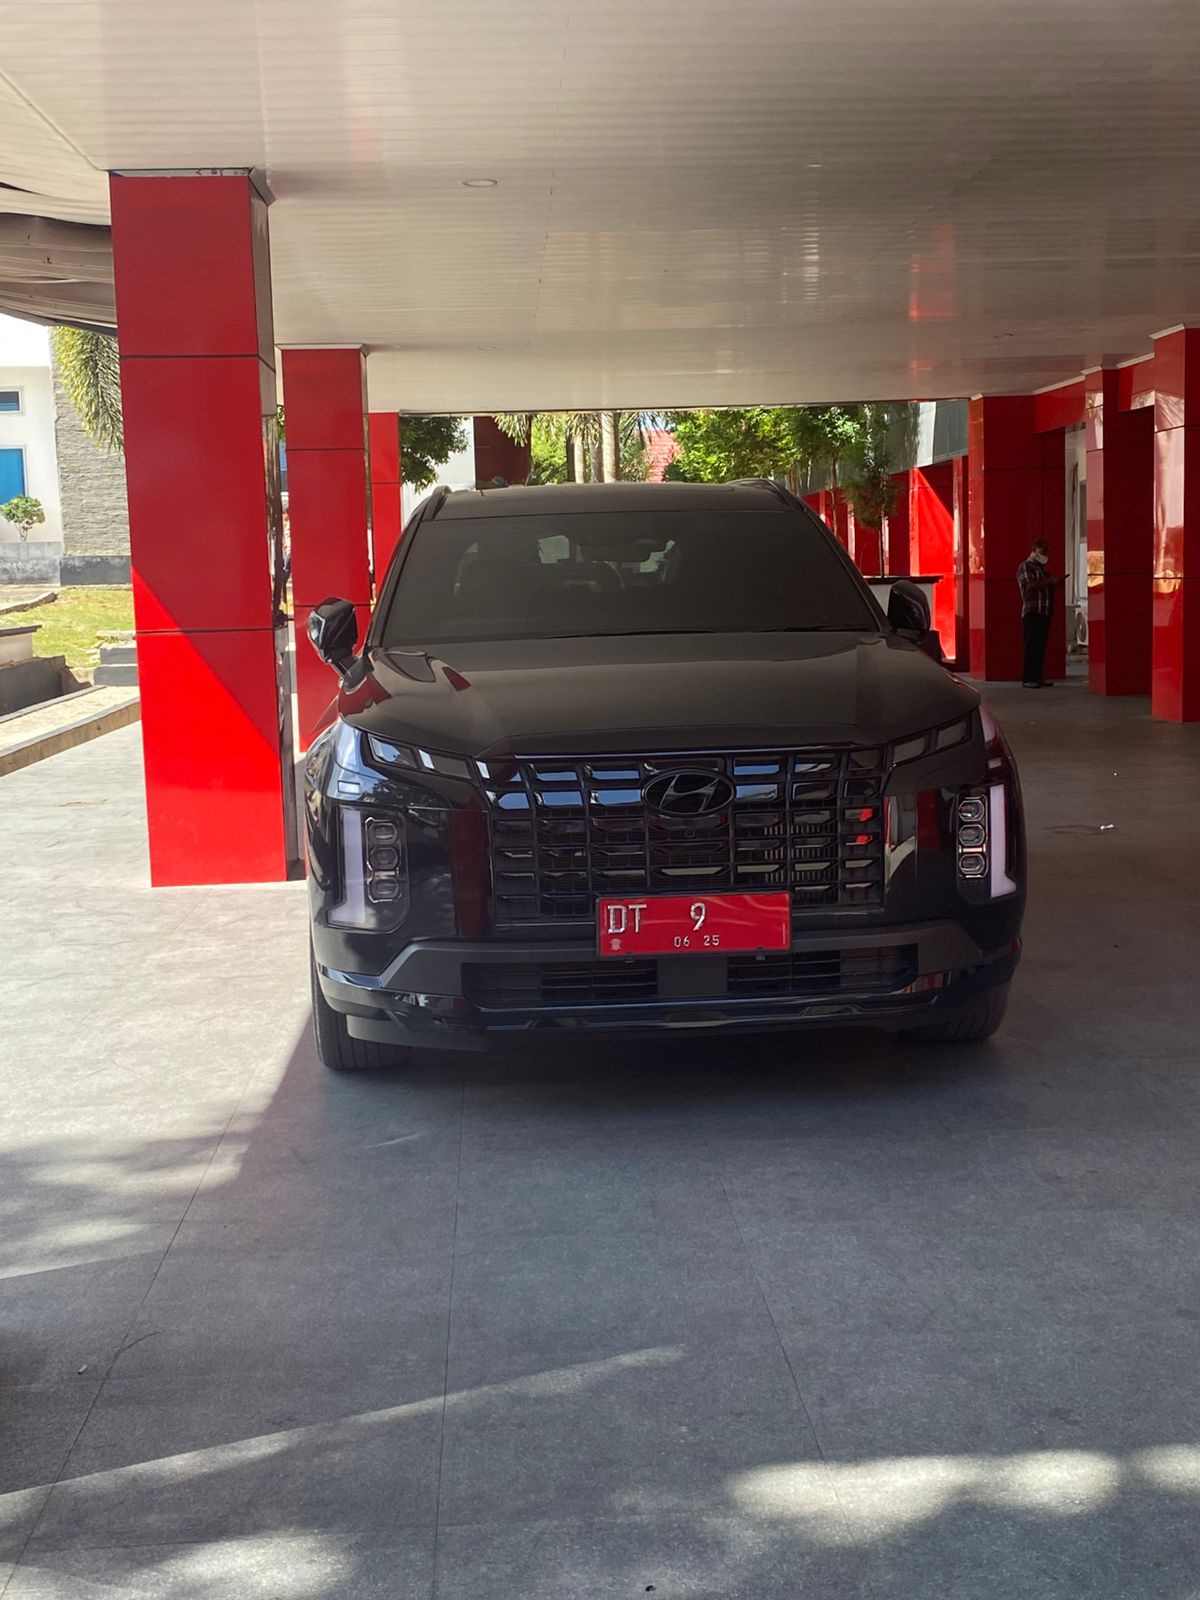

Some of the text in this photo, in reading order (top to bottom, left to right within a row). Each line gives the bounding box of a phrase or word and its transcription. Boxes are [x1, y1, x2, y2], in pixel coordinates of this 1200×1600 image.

[607, 902, 706, 934] DT 9
[674, 935, 720, 948] 06 25
